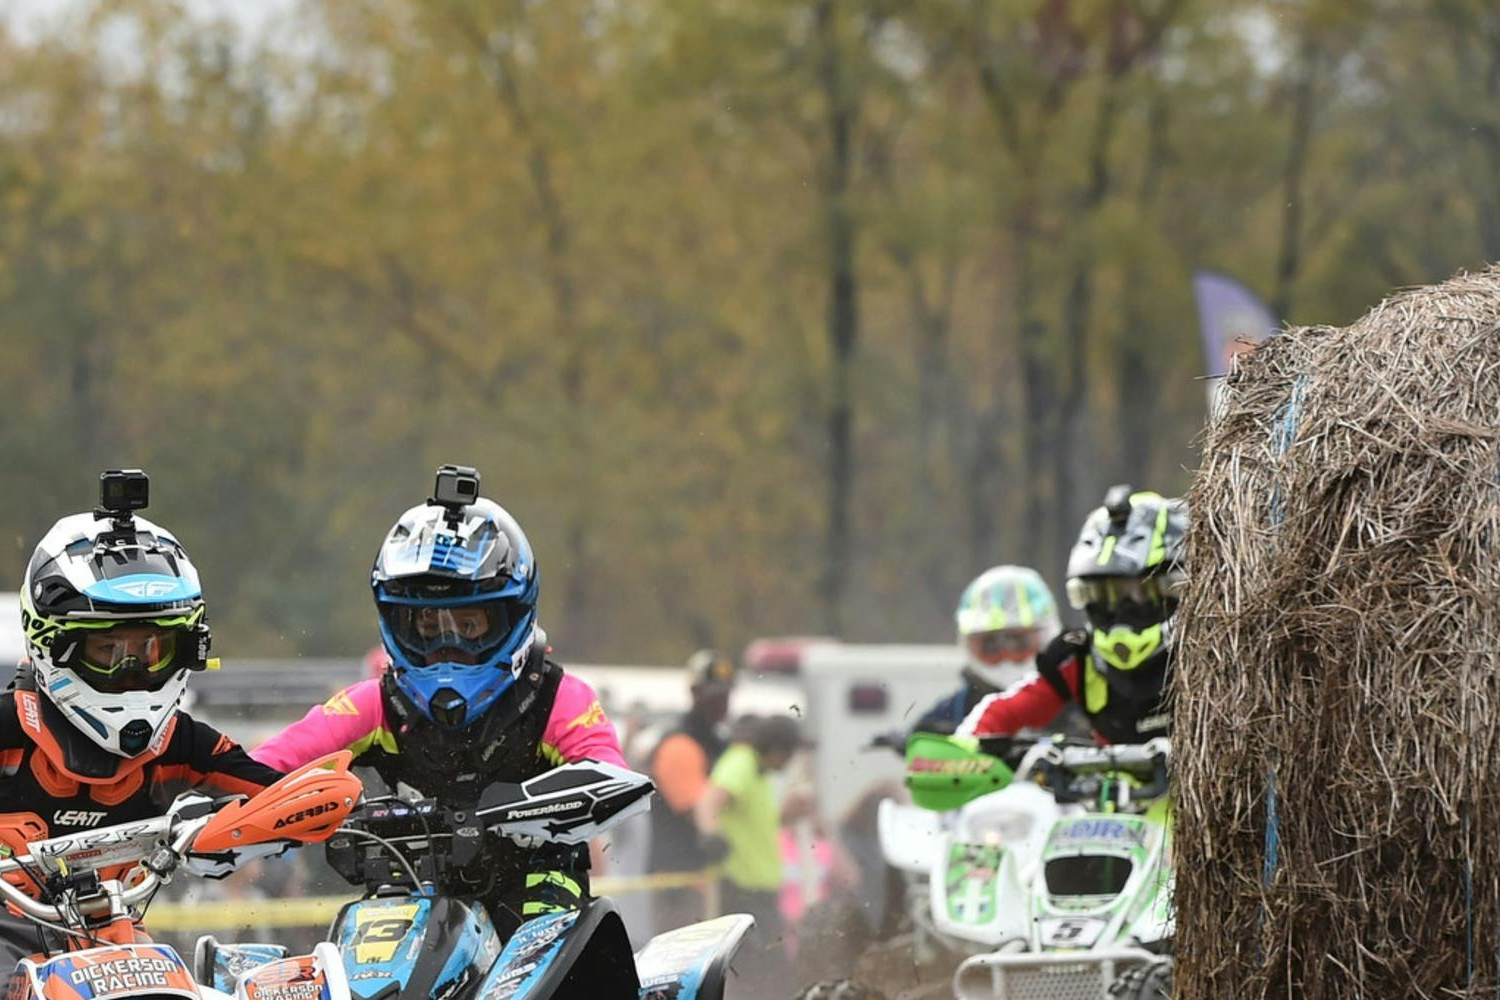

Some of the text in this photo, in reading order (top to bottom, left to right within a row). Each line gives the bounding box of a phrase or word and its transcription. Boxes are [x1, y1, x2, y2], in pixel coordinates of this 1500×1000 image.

[22, 693, 41, 733] LEATT
[53, 810, 108, 827] LEATT
[273, 801, 339, 830] ACERBIS
[70, 958, 178, 985] DICKERSON
[93, 973, 167, 993] RACING
[253, 983, 323, 999] DICKERSON
